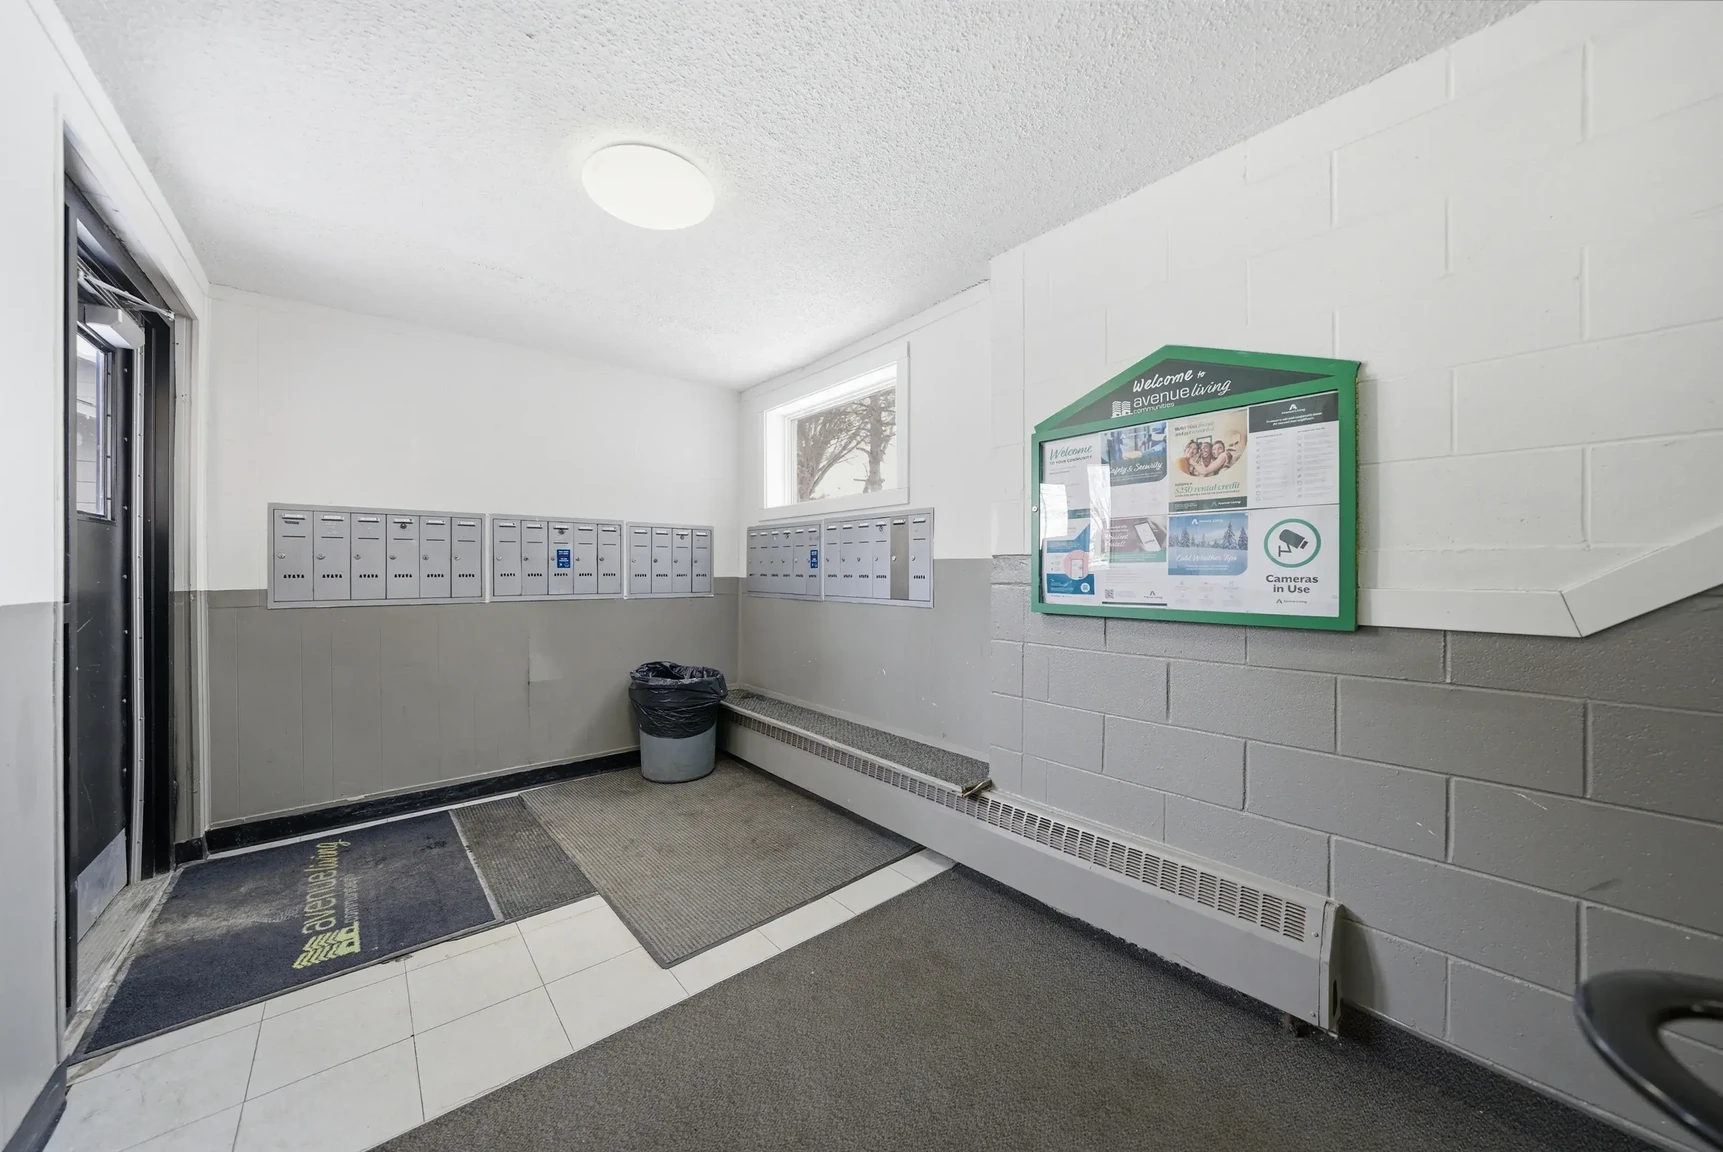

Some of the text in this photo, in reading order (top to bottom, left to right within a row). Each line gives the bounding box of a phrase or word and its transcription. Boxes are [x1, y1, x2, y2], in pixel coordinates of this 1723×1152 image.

[1133, 370, 1206, 392] Welcome to
[1133, 380, 1231, 407] avenue living
[1133, 402, 1175, 415] communities
[1050, 445, 1092, 460] Welcome
[1175, 485, 1193, 495] $250
[1194, 483, 1217, 492] rental
[1217, 481, 1240, 490] credit
[1265, 574, 1319, 584] Cameras
[1273, 584, 1311, 594] in Use
[302, 839, 351, 934] avenue living
